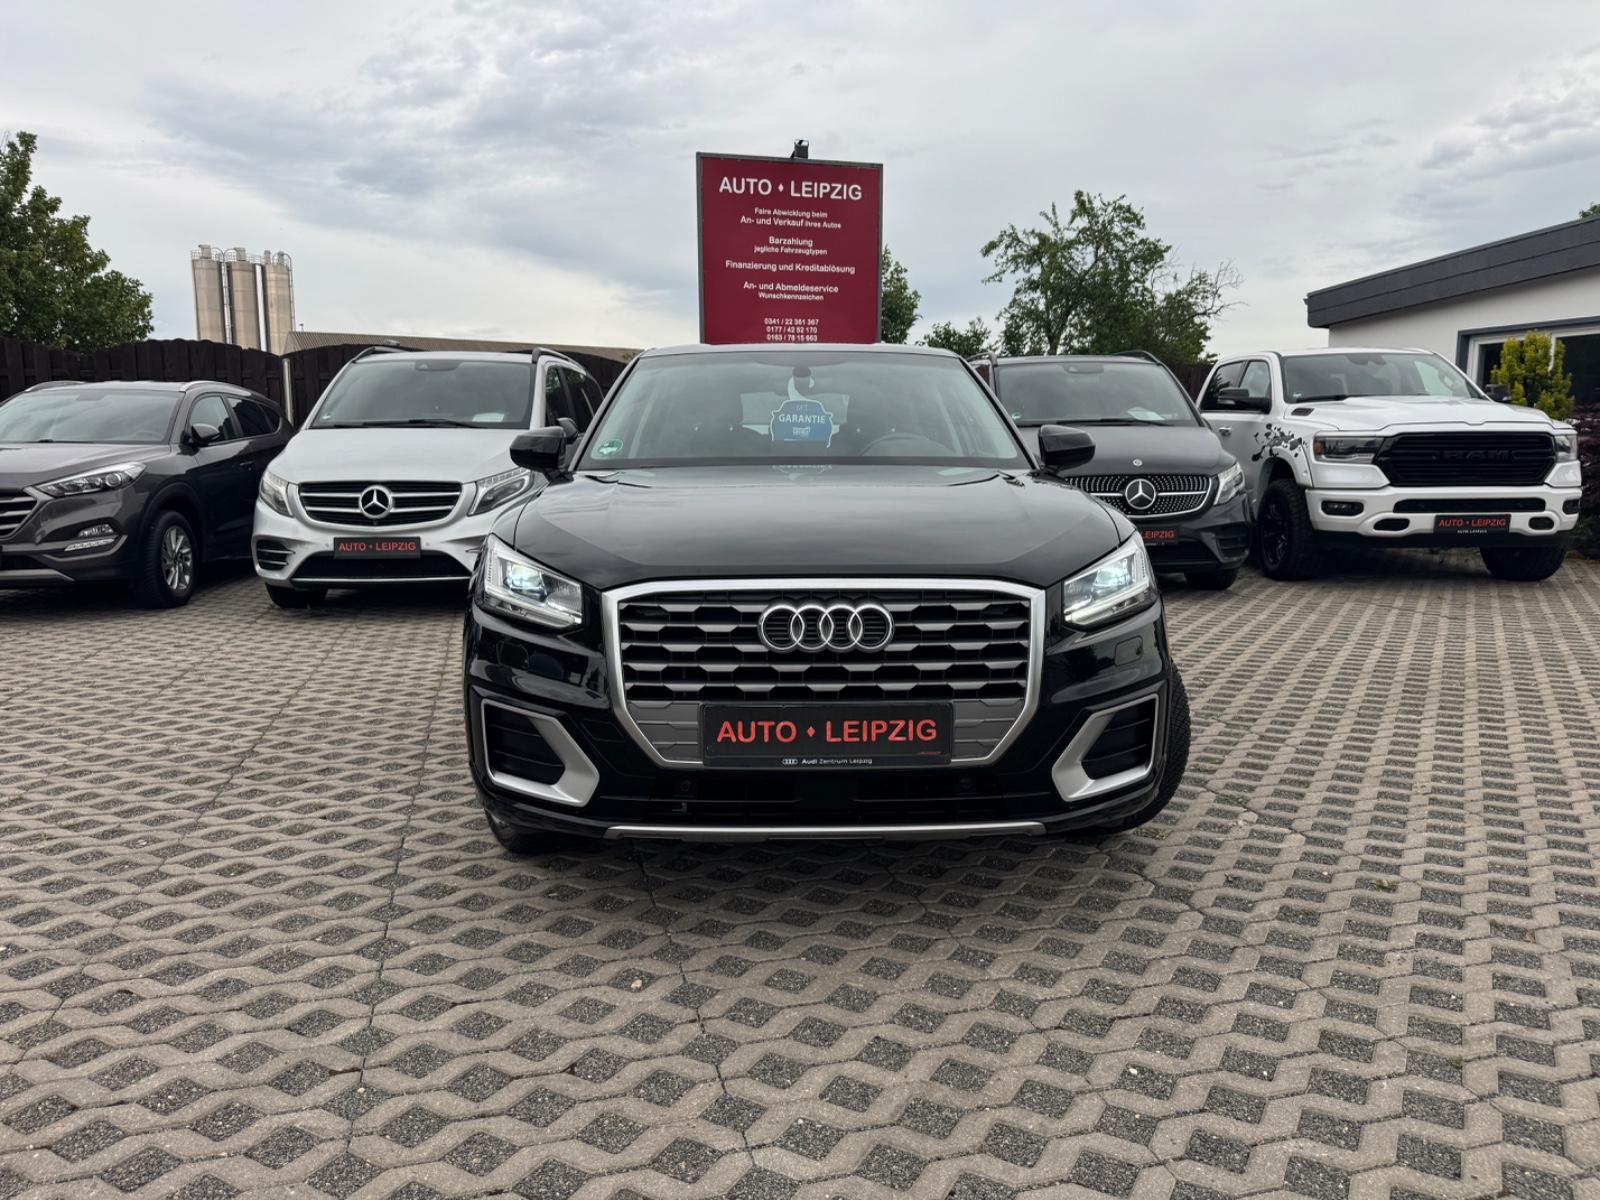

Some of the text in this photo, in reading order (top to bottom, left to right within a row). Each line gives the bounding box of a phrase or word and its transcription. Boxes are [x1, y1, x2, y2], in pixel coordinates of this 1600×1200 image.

[719, 177, 862, 200] AUTO LEIPZIG
[754, 207, 772, 215] Faire
[773, 208, 810, 218] Abwicklung
[740, 216, 754, 224] An-
[756, 217, 772, 225] und
[773, 218, 804, 226] Verkauf
[769, 236, 813, 247] Barzahlung
[780, 246, 828, 255] Fahrzeugtypen
[726, 260, 856, 274] Finanzierung und Kreditablösung
[744, 281, 838, 293] An- und Abmeldeservice
[758, 292, 824, 300] Wunschkennzeichen
[779, 413, 826, 424] GARANTIE
[1439, 518, 1506, 527] AUTO LEIPZIG
[338, 542, 416, 552] AUTO LEIPZIG
[716, 719, 937, 743] AUTO LEIPZIG
